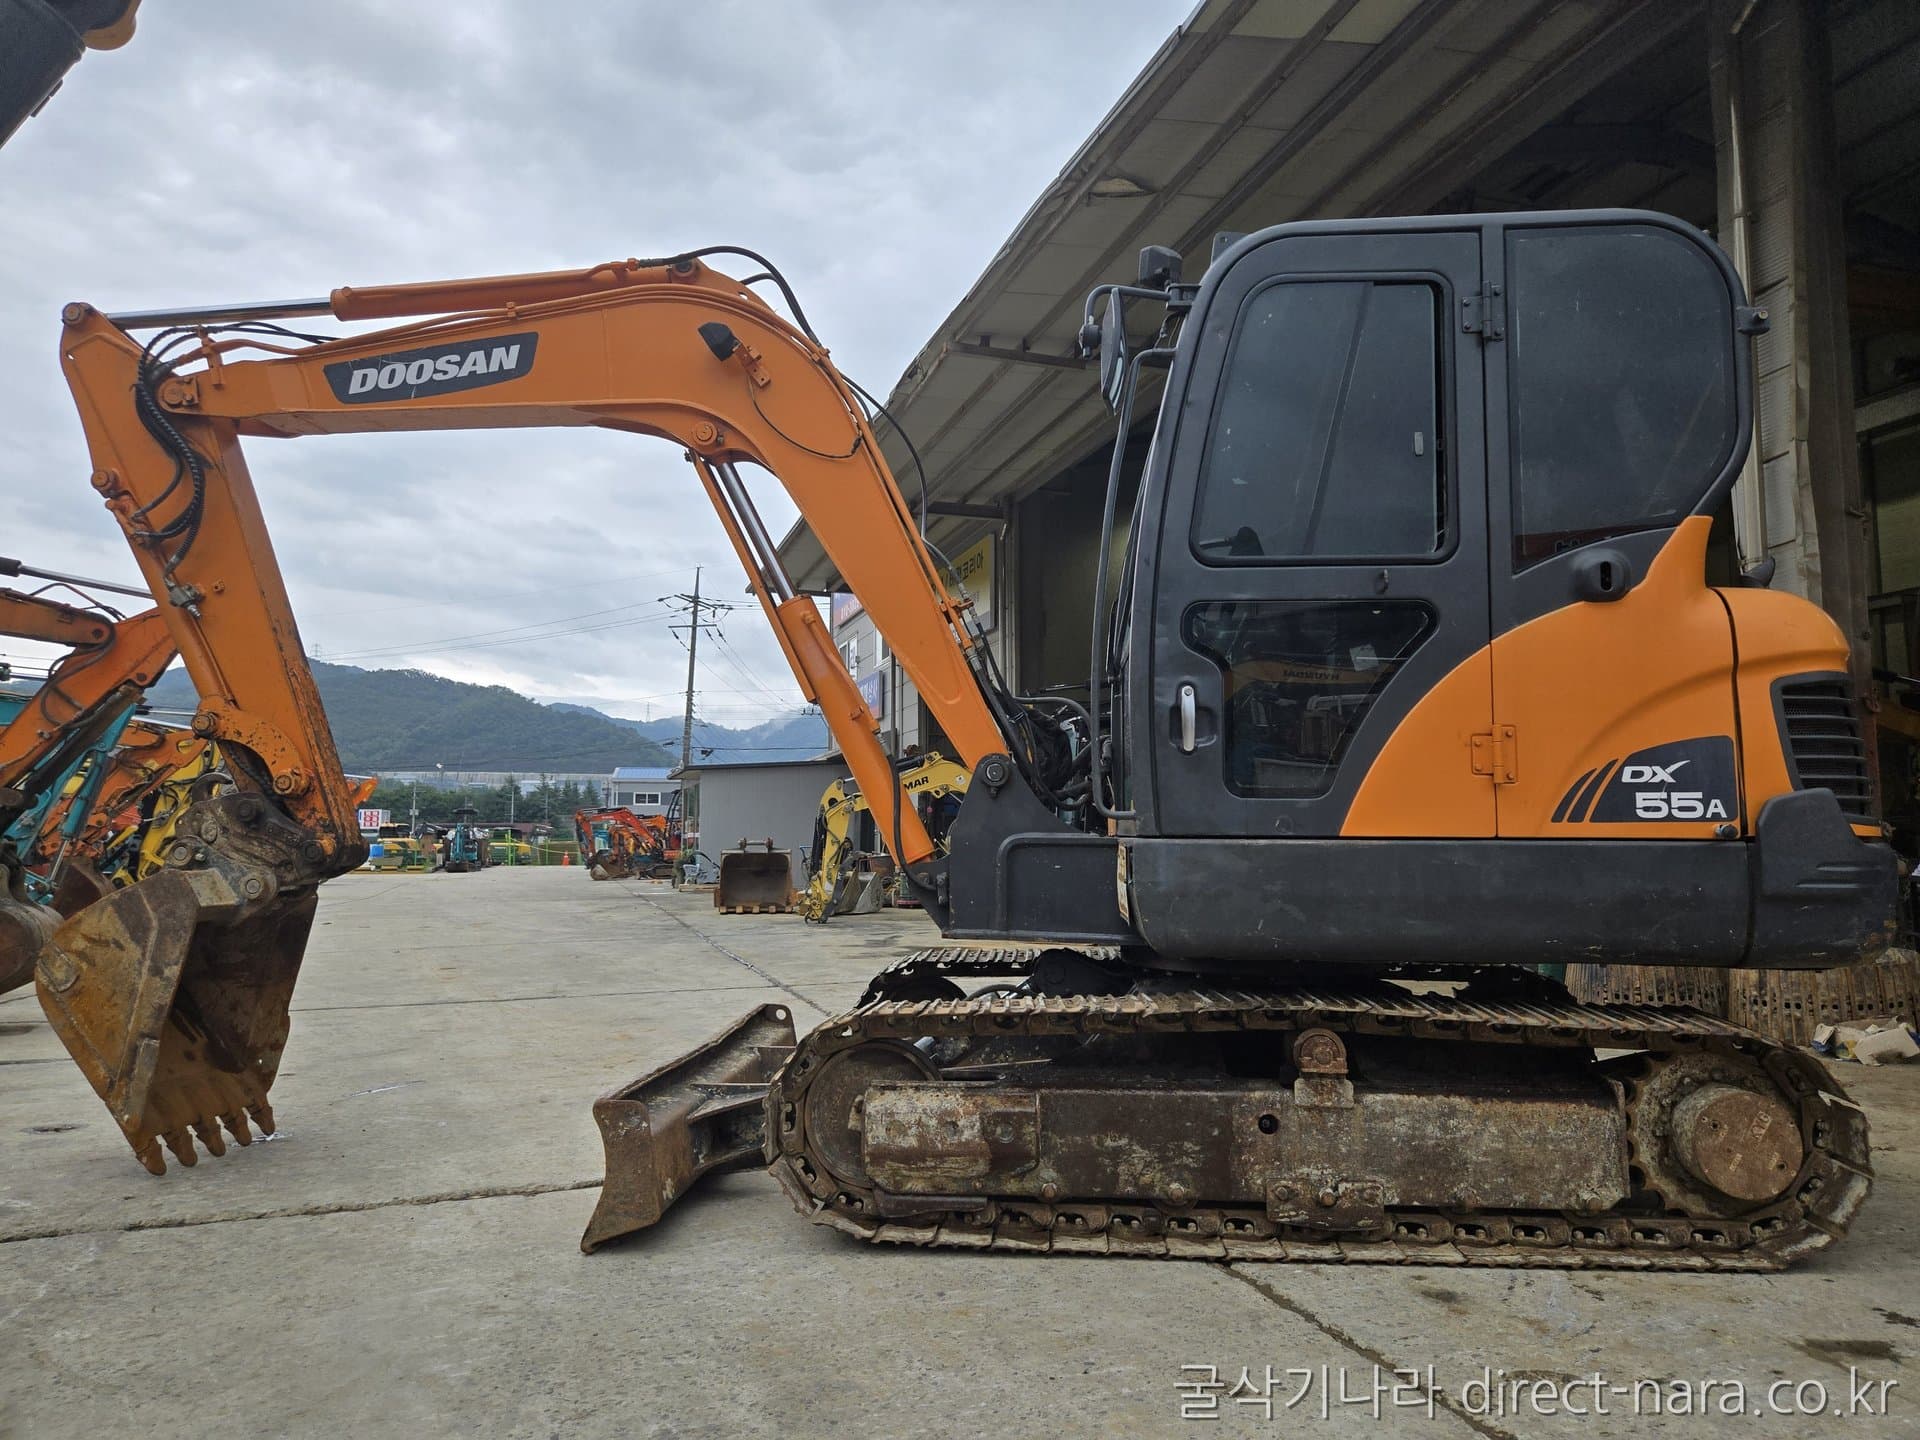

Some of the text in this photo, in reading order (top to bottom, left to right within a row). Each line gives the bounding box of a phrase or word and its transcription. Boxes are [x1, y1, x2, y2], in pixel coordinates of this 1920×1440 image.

[348, 345, 521, 395] DOOSAN
[1621, 760, 1690, 783] DX
[1635, 792, 1727, 819] 55A
